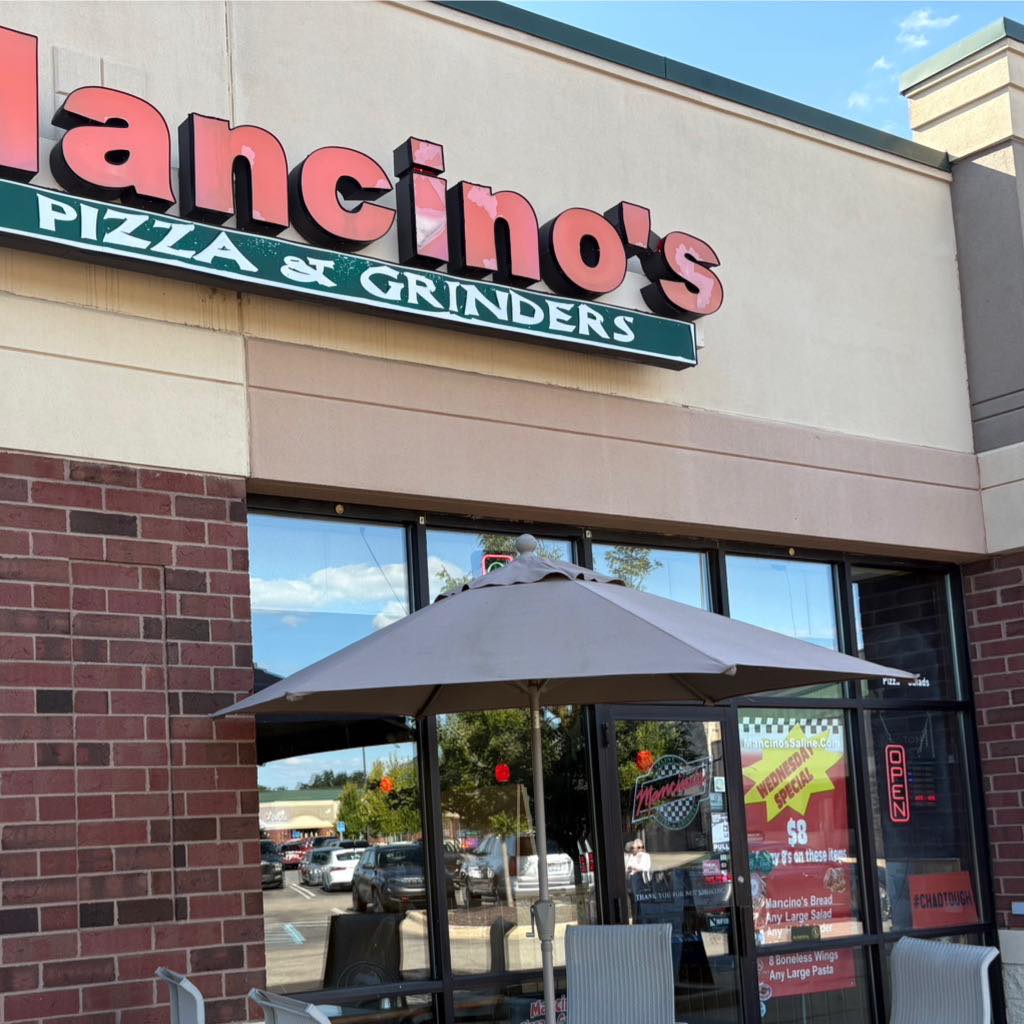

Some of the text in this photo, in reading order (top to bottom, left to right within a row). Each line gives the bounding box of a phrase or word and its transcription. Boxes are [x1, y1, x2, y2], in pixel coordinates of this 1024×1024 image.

[36, 193, 636, 344] PIZZA & GRINDERS
[756, 746, 814, 800] WEDNESDAY
[889, 750, 907, 818] OPEN
[773, 767, 814, 810] SPECIAL
[787, 818, 808, 847] $8
[794, 852, 805, 863] on
[805, 849, 827, 862] these
[810, 895, 833, 906] Bread
[766, 908, 832, 925] Any Large Salad
[776, 952, 812, 966] Boneless
[814, 950, 838, 963] Wings
[769, 965, 834, 982] Any Large Pasta
